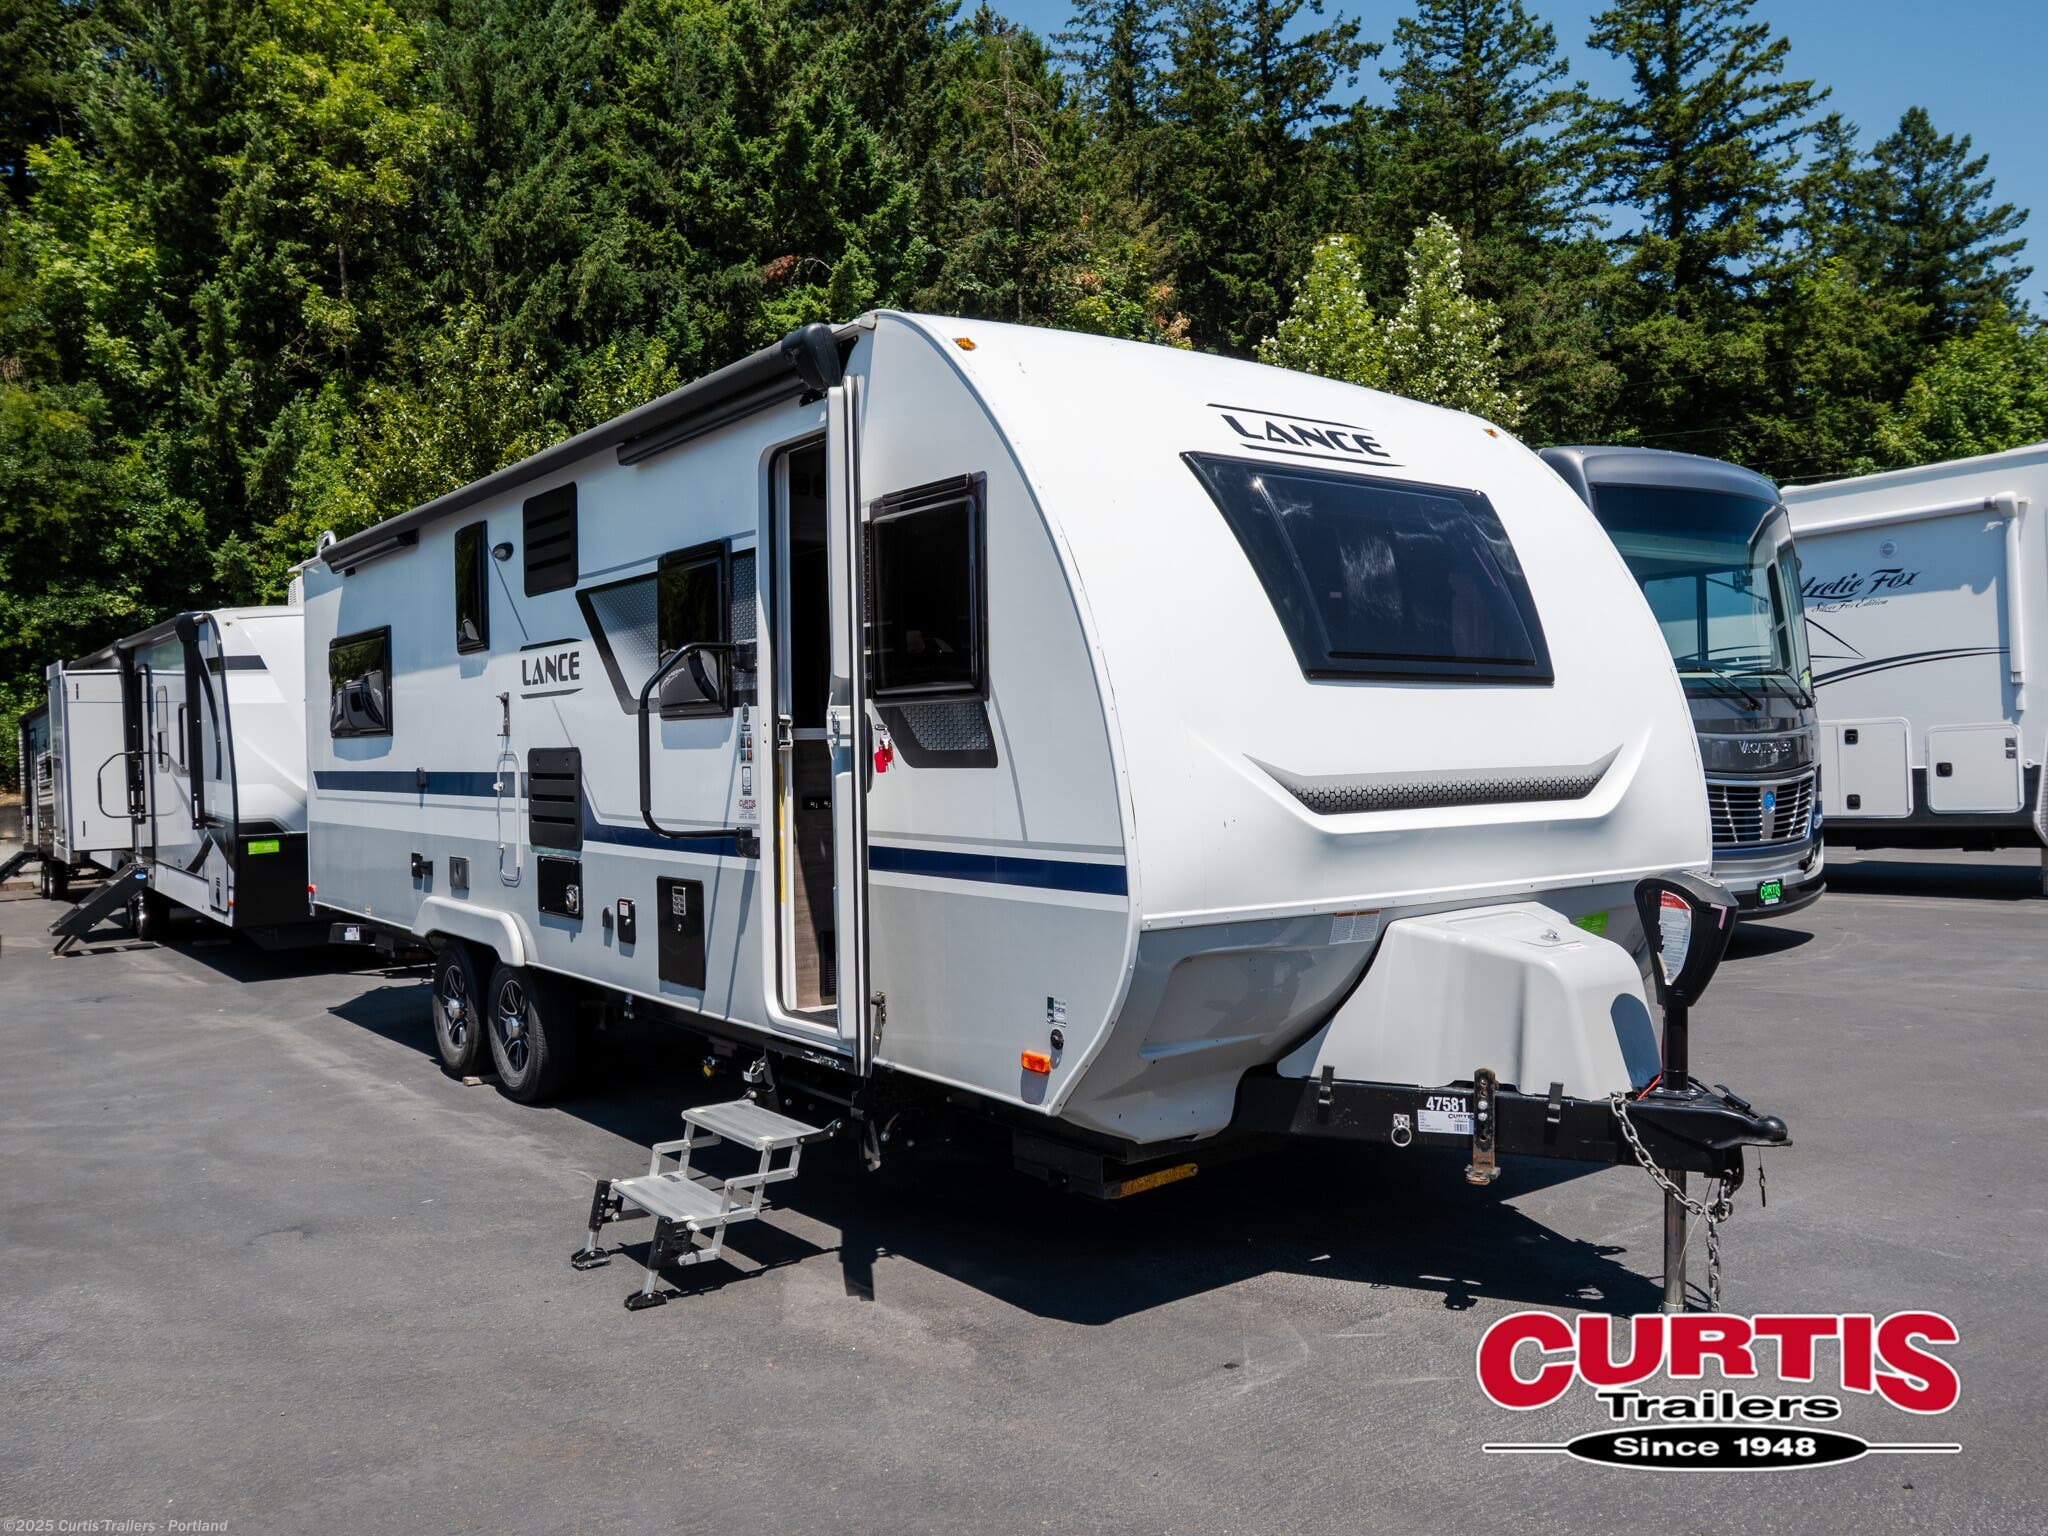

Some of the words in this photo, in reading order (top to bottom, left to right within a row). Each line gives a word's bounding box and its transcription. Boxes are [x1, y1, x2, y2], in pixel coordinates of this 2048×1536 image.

[1220, 413, 1391, 458] LANCE
[1868, 568, 1921, 594] Fox
[521, 651, 580, 686] LANCE
[1425, 1096, 1467, 1113] 47581
